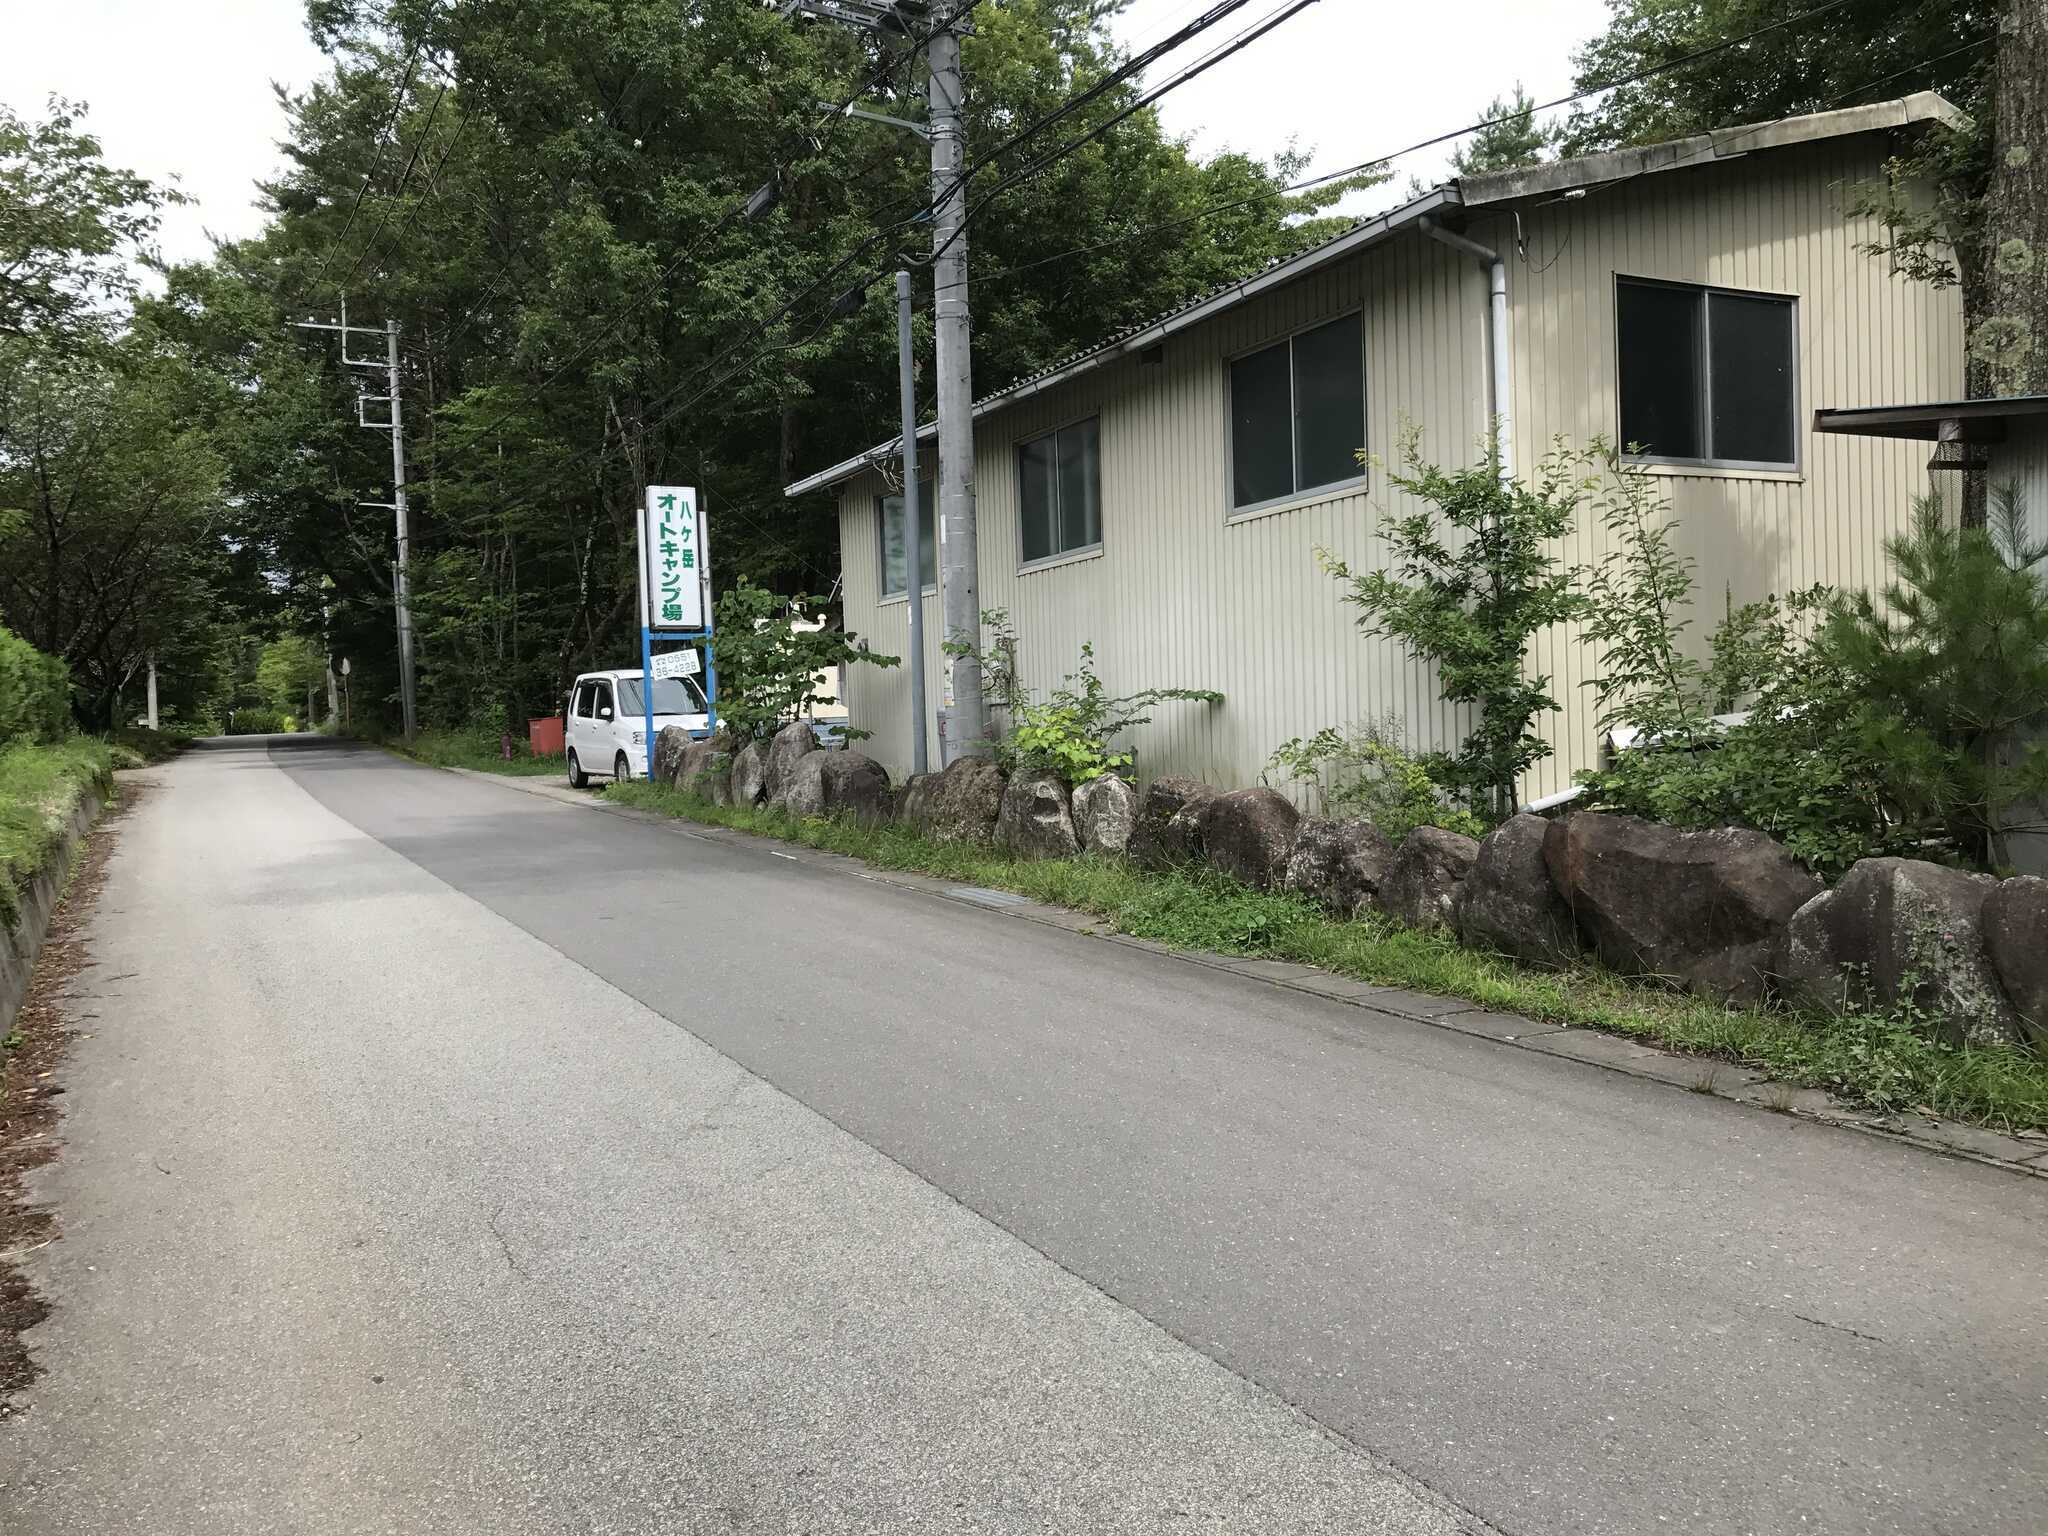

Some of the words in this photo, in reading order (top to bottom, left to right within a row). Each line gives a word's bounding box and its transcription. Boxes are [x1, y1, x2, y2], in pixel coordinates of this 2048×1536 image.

[657, 494, 683, 621] オートキャンプ場
